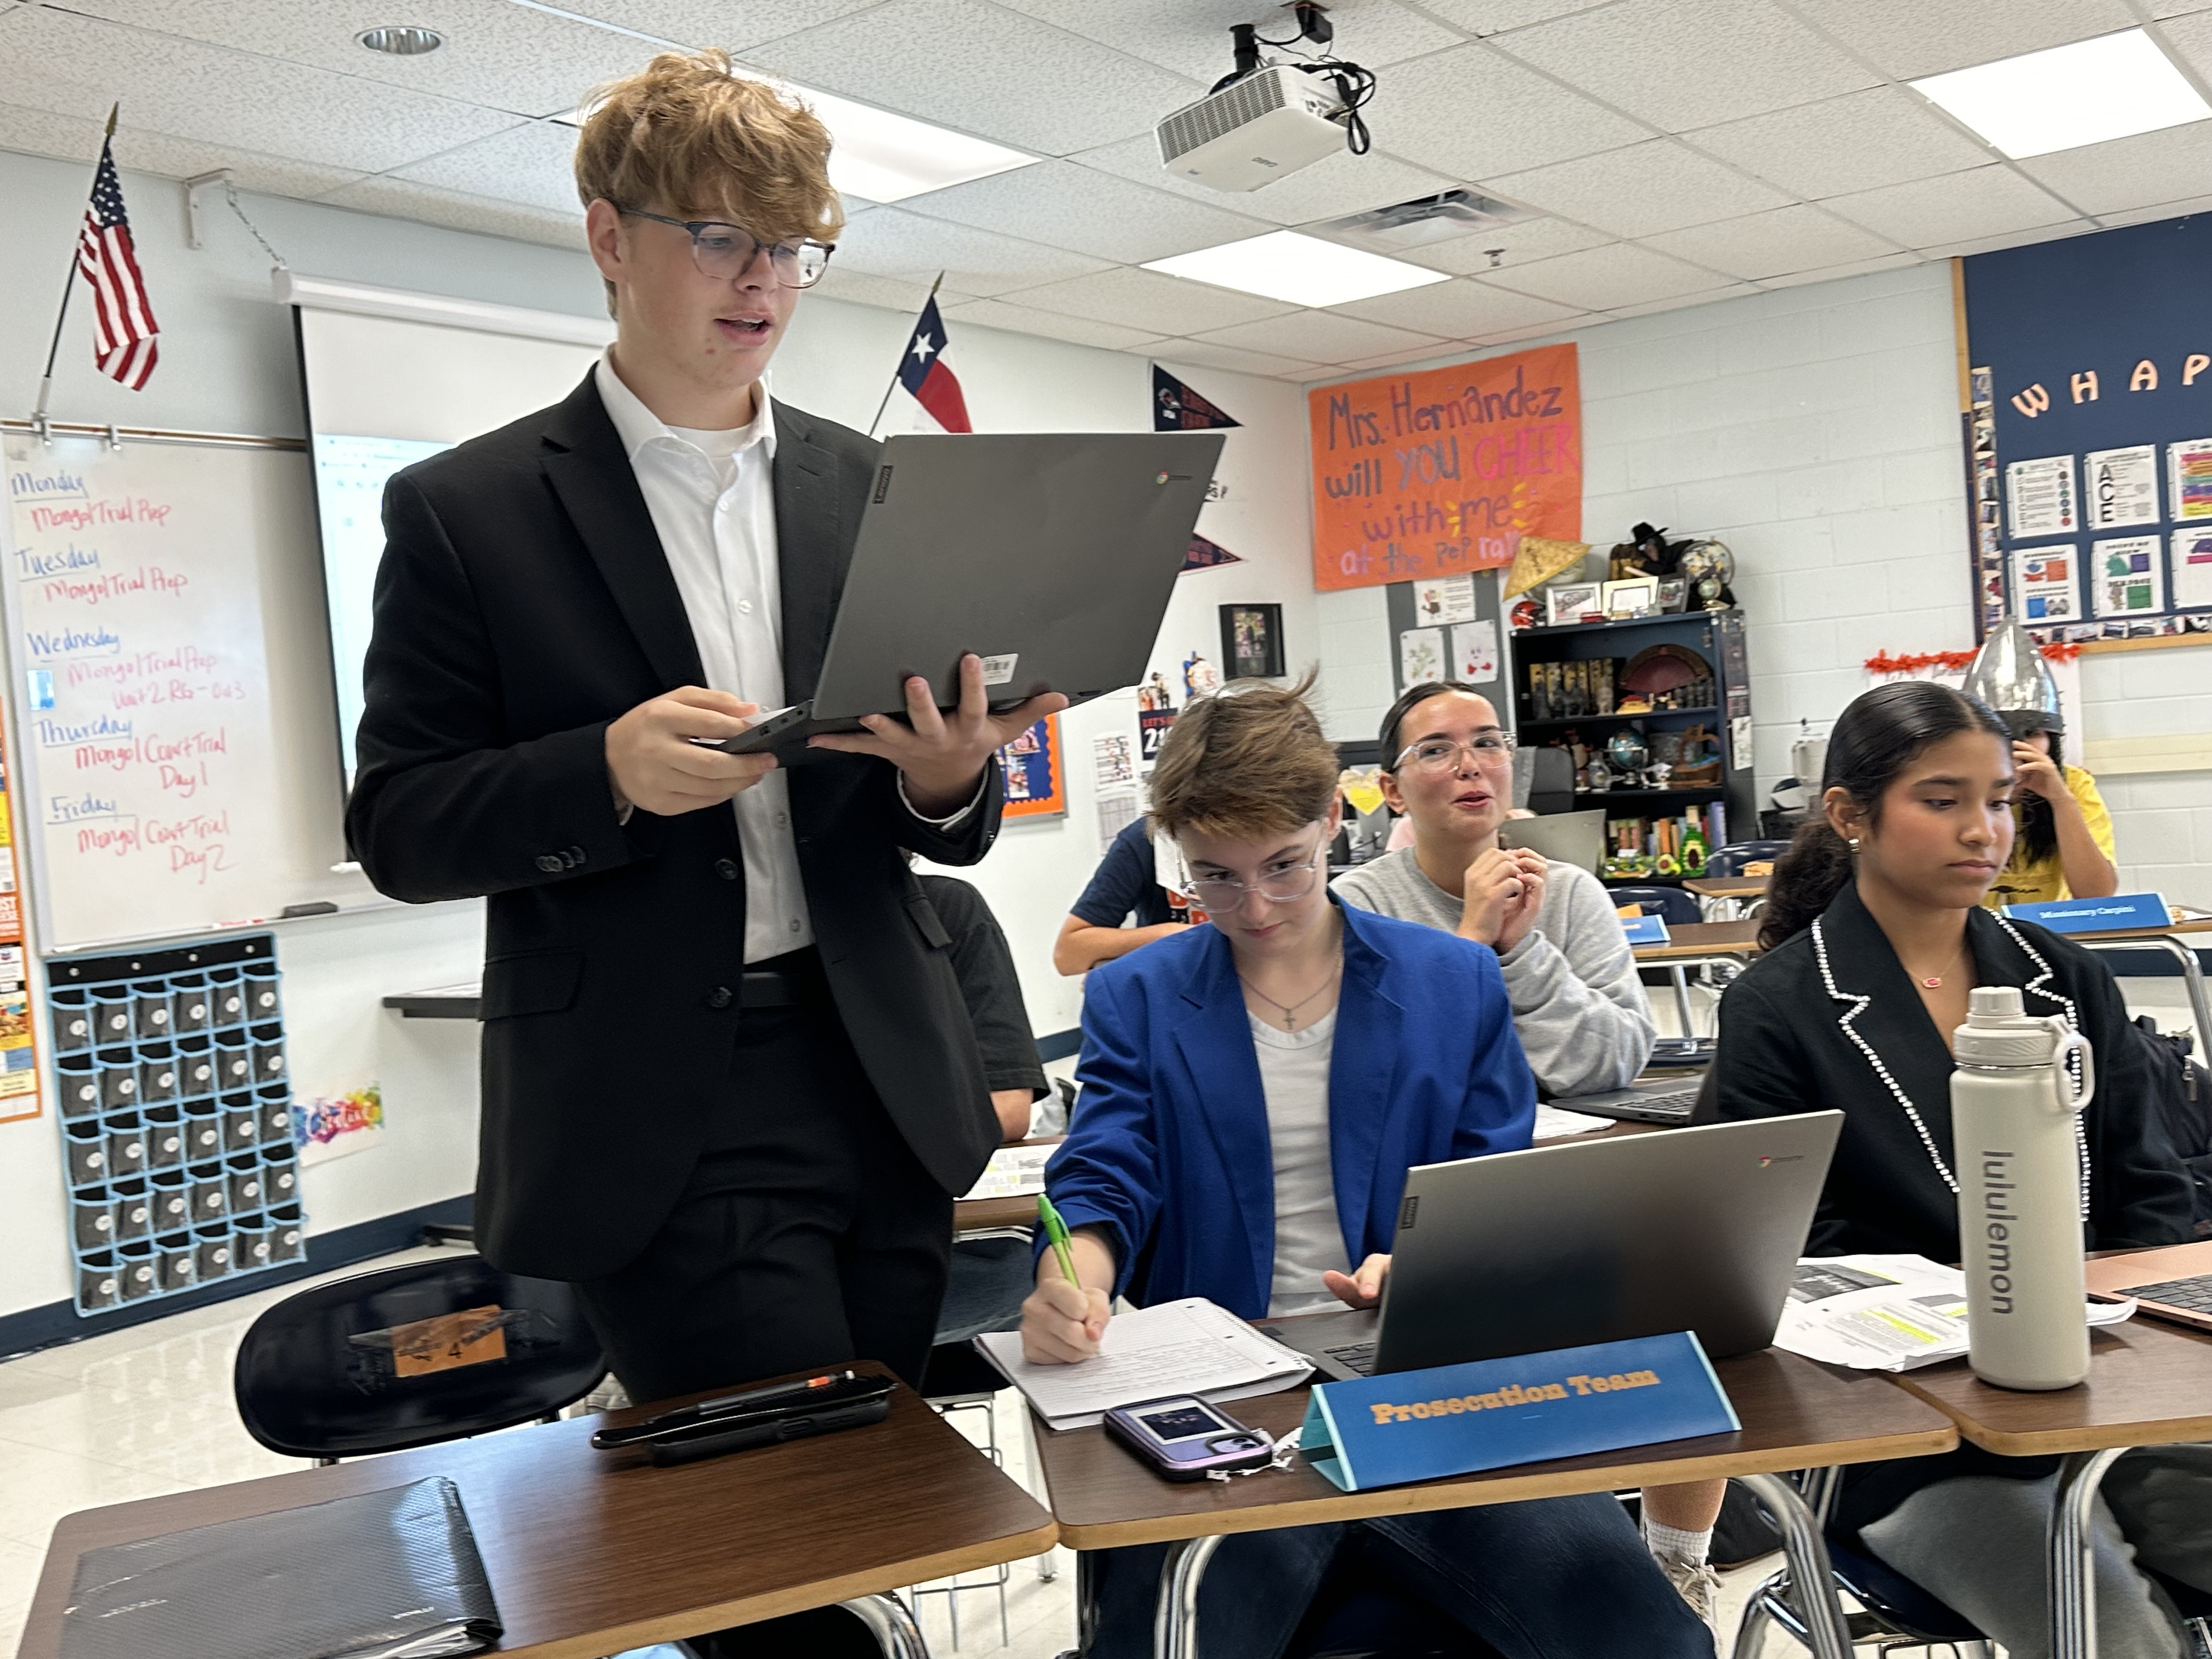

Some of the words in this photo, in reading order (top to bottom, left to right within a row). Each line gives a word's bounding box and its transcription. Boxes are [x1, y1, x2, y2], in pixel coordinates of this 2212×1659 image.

[1329, 392, 1386, 450] Mrs.
[1324, 459, 1382, 498] will
[1473, 422, 1581, 481] CHEER
[10, 470, 89, 499] Monday
[31, 500, 94, 532] Mongol
[92, 495, 134, 523] Trial
[138, 498, 172, 527] Prep
[1362, 500, 1447, 543] with
[1459, 494, 1513, 533] me
[14, 542, 101, 575] Tuesday
[1340, 543, 1374, 576] at
[1383, 542, 1424, 575] the
[44, 574, 109, 605] Mongol
[108, 566, 146, 594] Trial
[149, 566, 188, 597] Prep
[26, 625, 121, 655] Wednesday
[67, 652, 143, 687] Mongol
[32, 714, 133, 743] Thursday
[75, 737, 142, 771] Mongol
[144, 732, 192, 763] Court
[191, 726, 227, 754] Trial
[158, 764, 196, 799] Day
[51, 792, 118, 821] Friday
[78, 816, 142, 857] Mongol
[144, 820, 189, 844] Court
[189, 809, 230, 839] Trial
[170, 844, 207, 885] Day
[205, 843, 240, 871] 2
[1980, 1150, 2018, 1315] lululemon
[1369, 1384, 1568, 1425] Prosecution
[1567, 1369, 1662, 1397] Team
